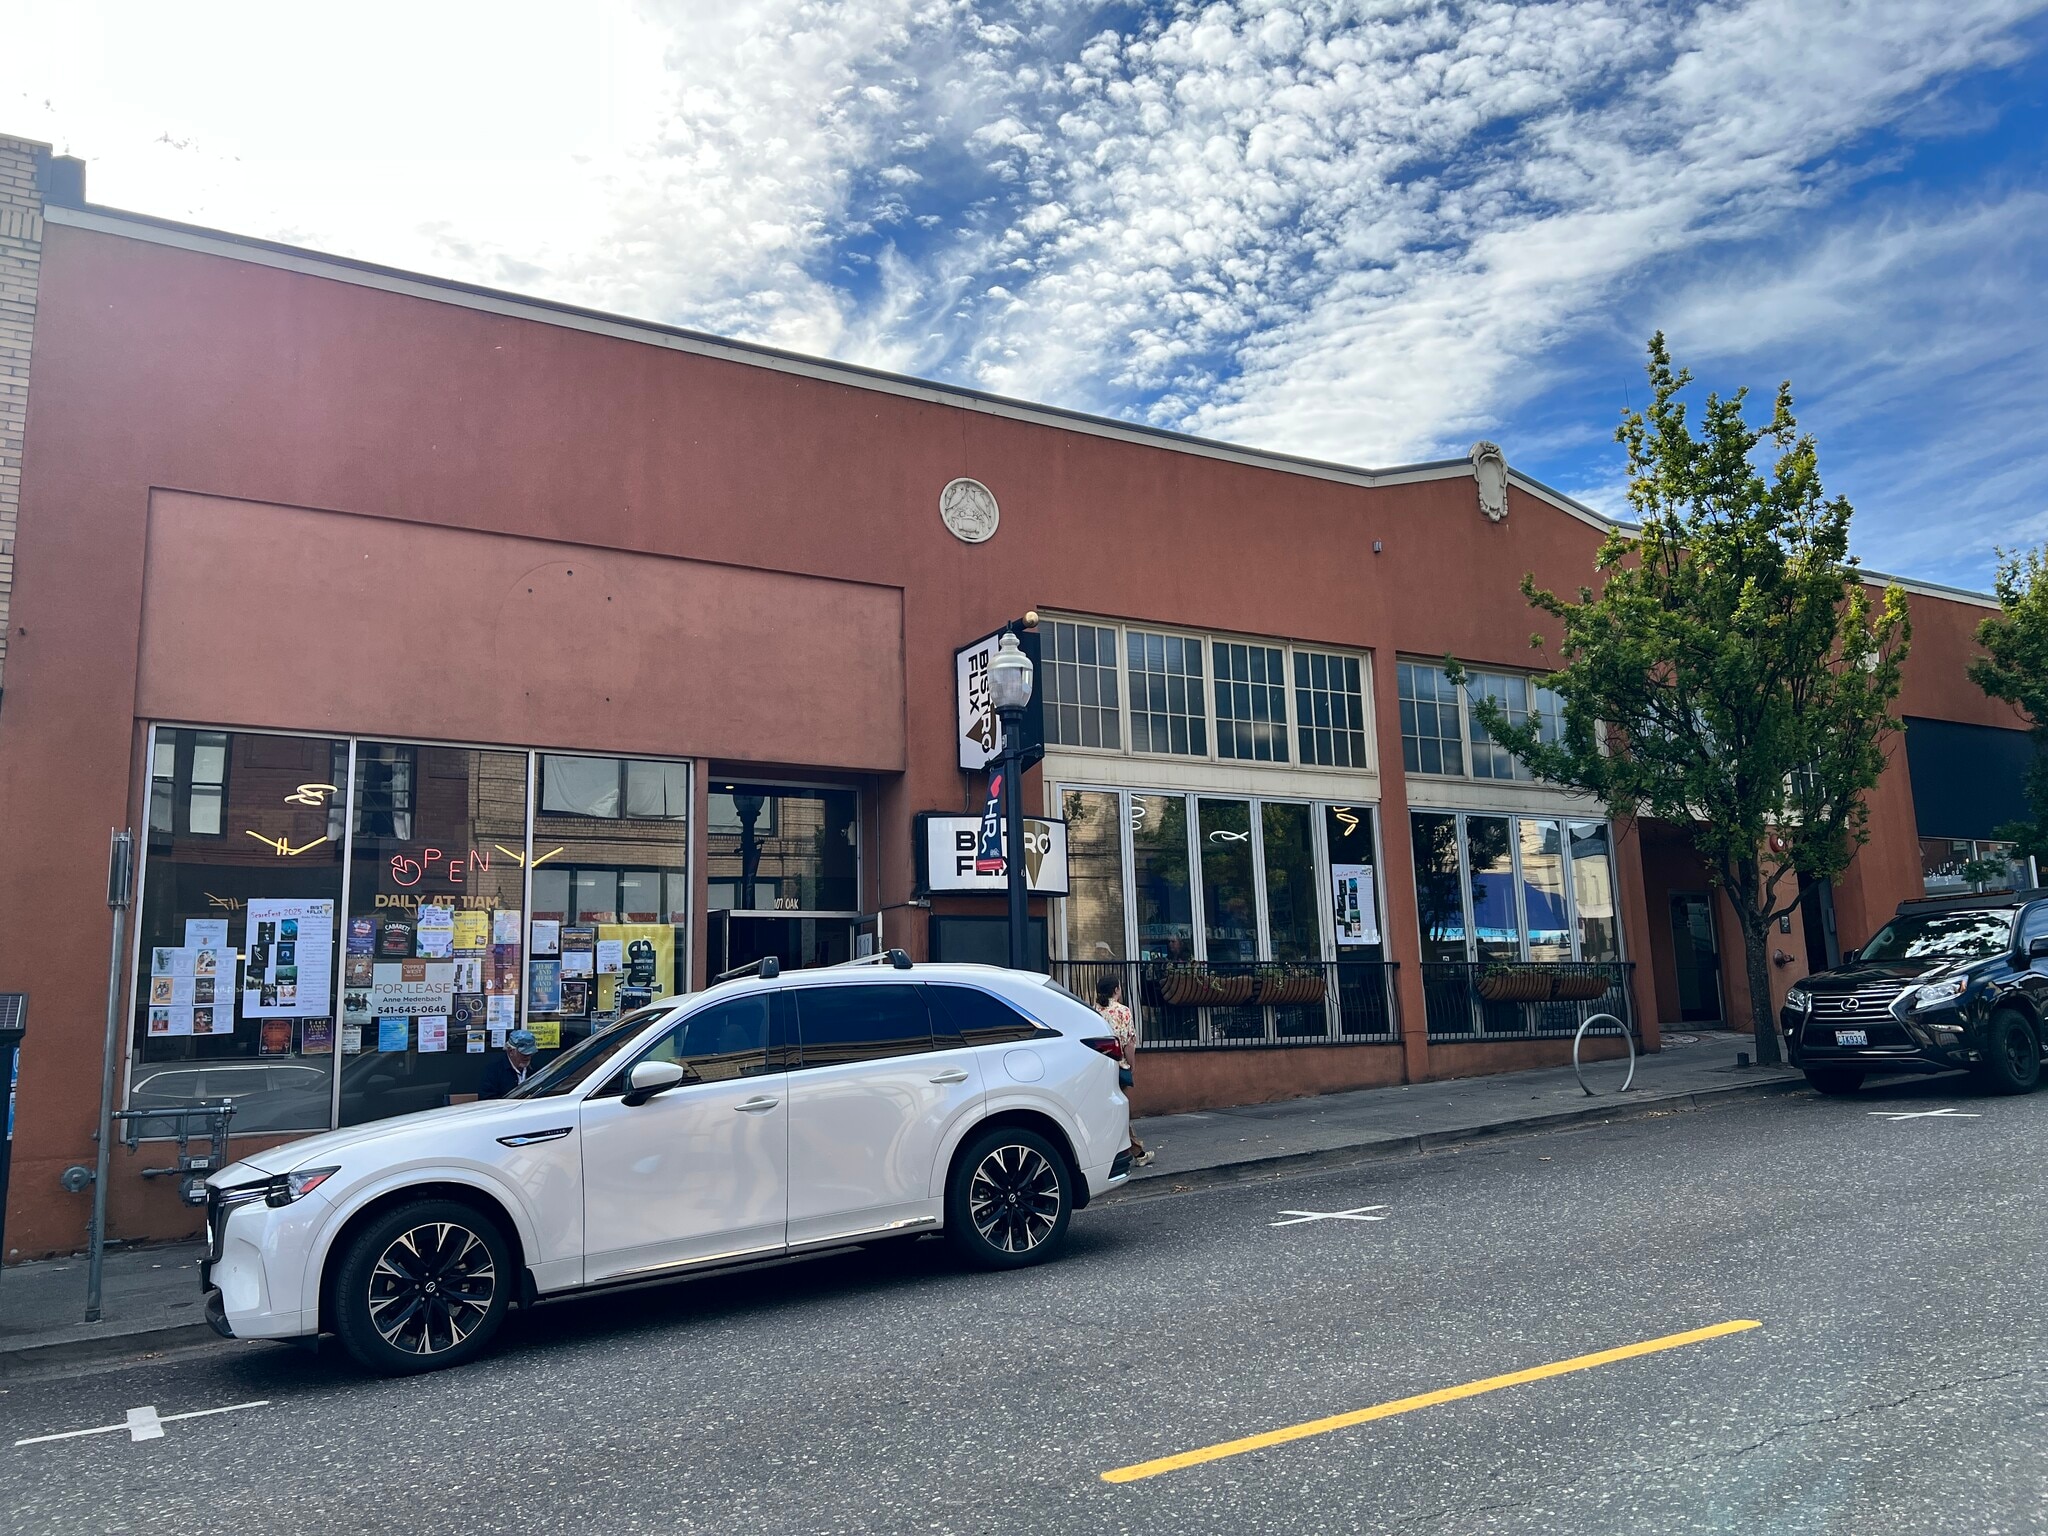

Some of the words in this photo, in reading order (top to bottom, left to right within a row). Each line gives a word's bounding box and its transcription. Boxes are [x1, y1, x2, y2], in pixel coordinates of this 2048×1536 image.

[968, 653, 980, 716] FLIX
[979, 648, 992, 754] BISTRO
[390, 848, 490, 886] OPEN
[374, 894, 427, 909] DAILY
[432, 895, 456, 909] AT
[460, 895, 500, 909] 11AM
[785, 898, 798, 910] OAK
[284, 908, 302, 916] 2025
[374, 984, 402, 994] FOR
[407, 982, 451, 994] LEASE
[377, 1005, 447, 1014] 541-645-0646
